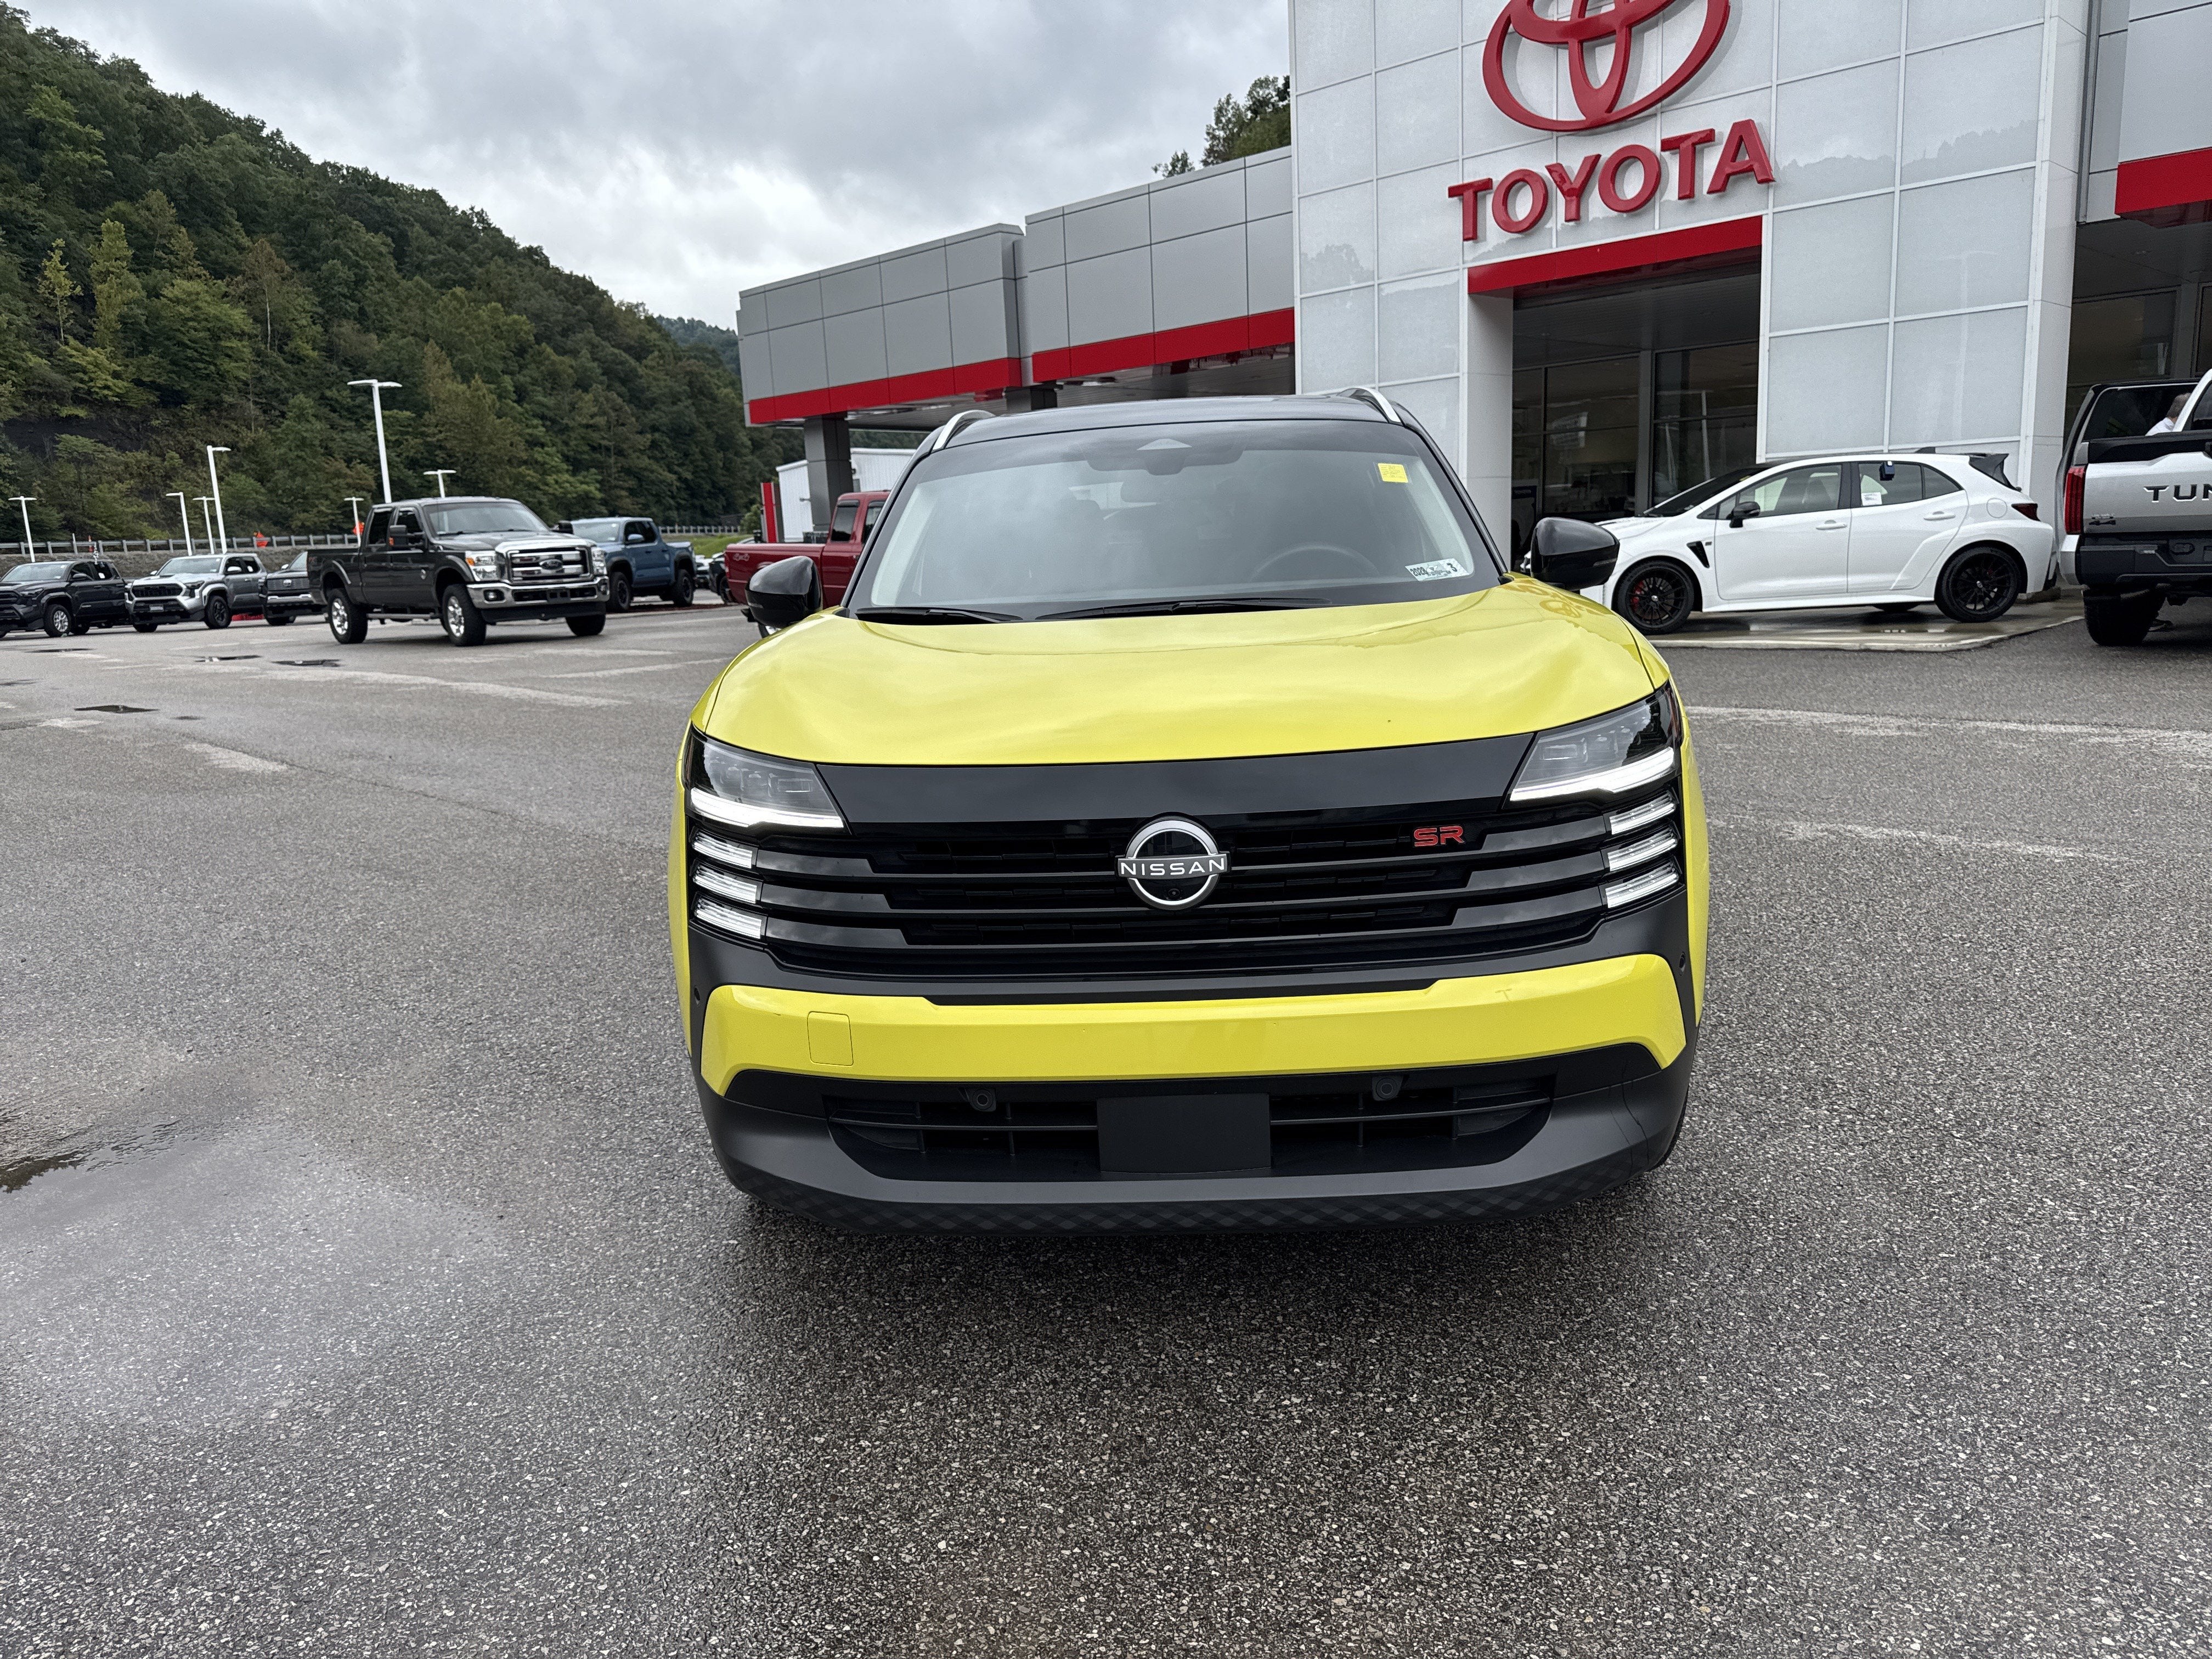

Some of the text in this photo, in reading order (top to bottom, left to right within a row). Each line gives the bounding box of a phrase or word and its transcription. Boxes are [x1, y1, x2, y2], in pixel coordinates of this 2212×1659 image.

[1448, 119, 1775, 242] TOYOTA
[1447, 563, 1458, 572] 3
[1413, 825, 1465, 847] SR
[1121, 857, 1224, 876] NISSAN
